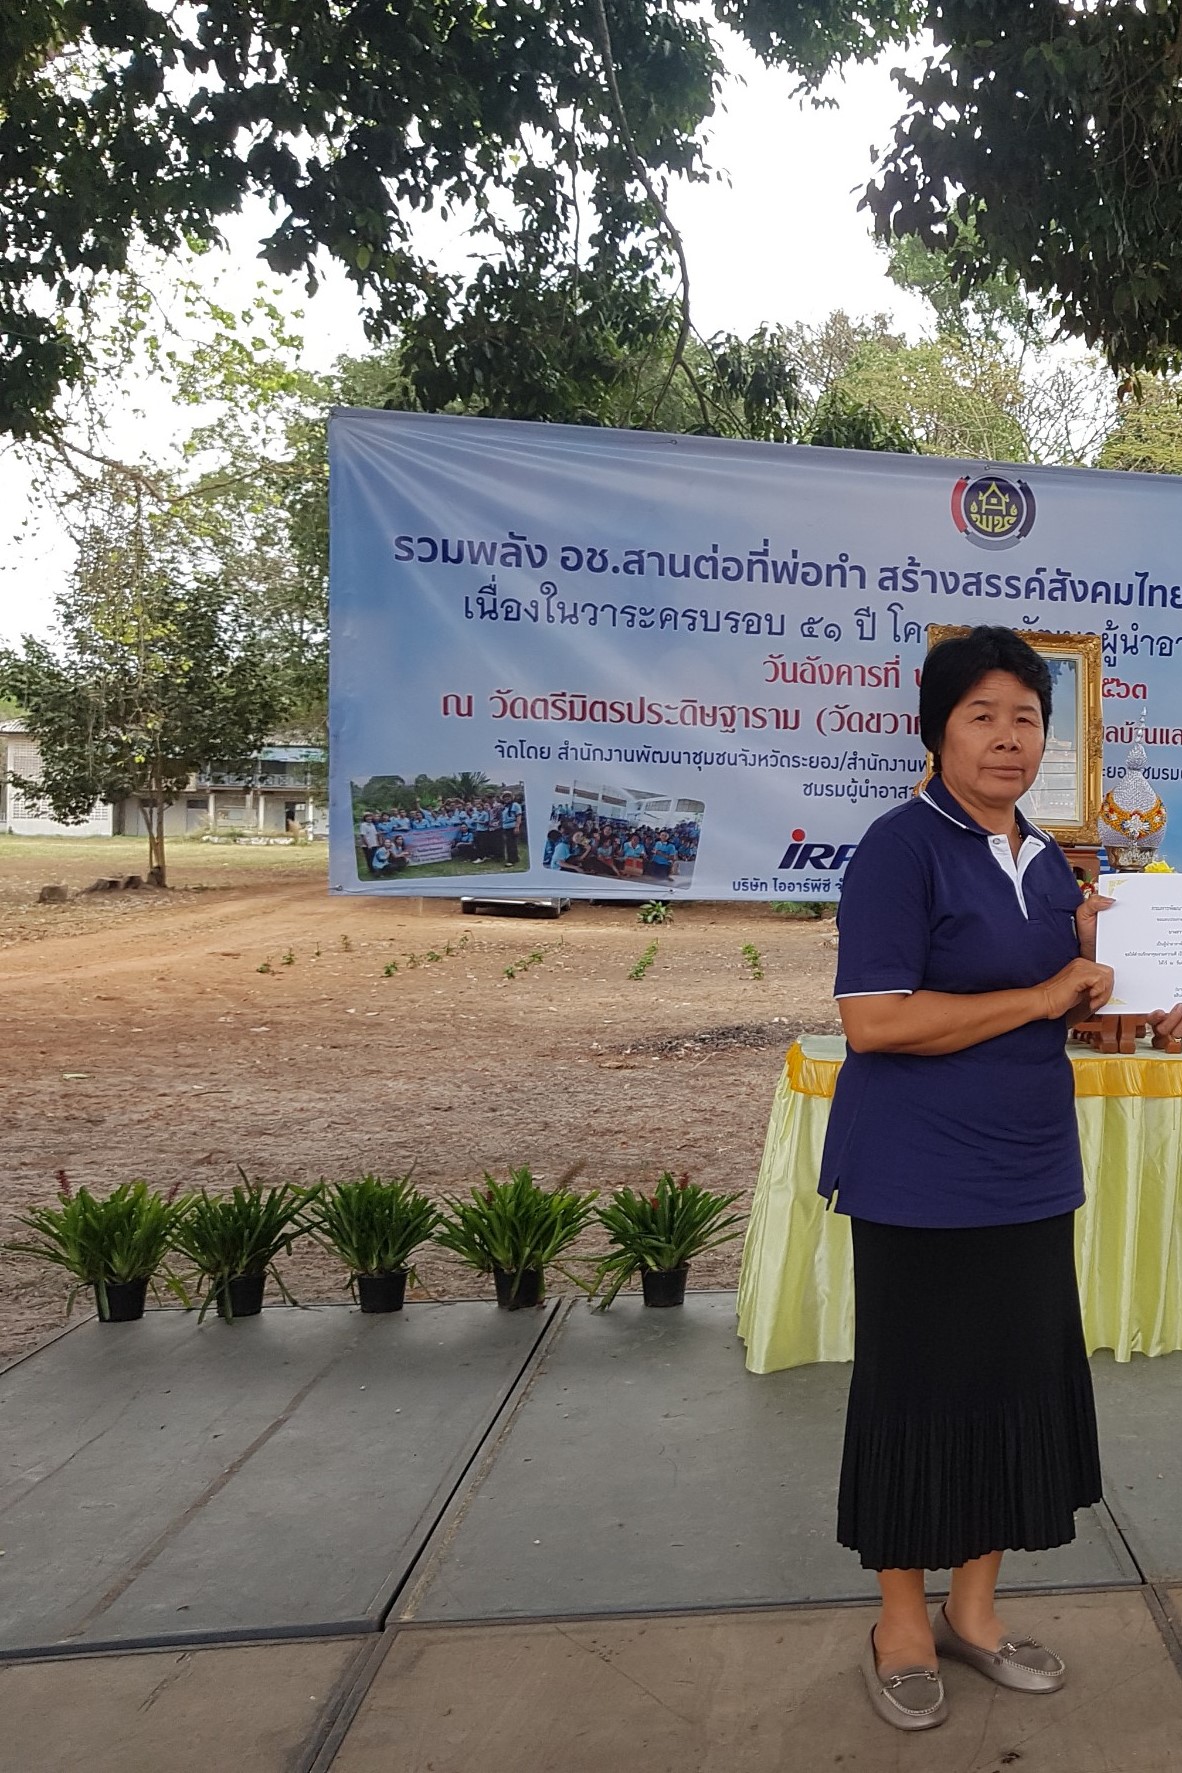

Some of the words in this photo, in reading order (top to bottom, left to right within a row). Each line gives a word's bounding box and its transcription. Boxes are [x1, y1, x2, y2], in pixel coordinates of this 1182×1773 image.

[394, 531, 549, 569] รวมพลัง
[560, 538, 867, 590] อช.สานต่อที่พ่อทำ
[464, 574, 785, 636] เนื่องในวาระครบรอบ
[800, 615, 842, 642] ๕๑
[854, 606, 876, 641] ปี
[763, 653, 900, 688] วันอังคารที่
[441, 693, 473, 718] ณ
[489, 688, 801, 734] วัดตรีมิตรประดิษฐาราม
[495, 739, 551, 760] จัดโดย
[732, 878, 768, 892] บริษัท
[773, 877, 831, 893] ไออาร์พีซี
